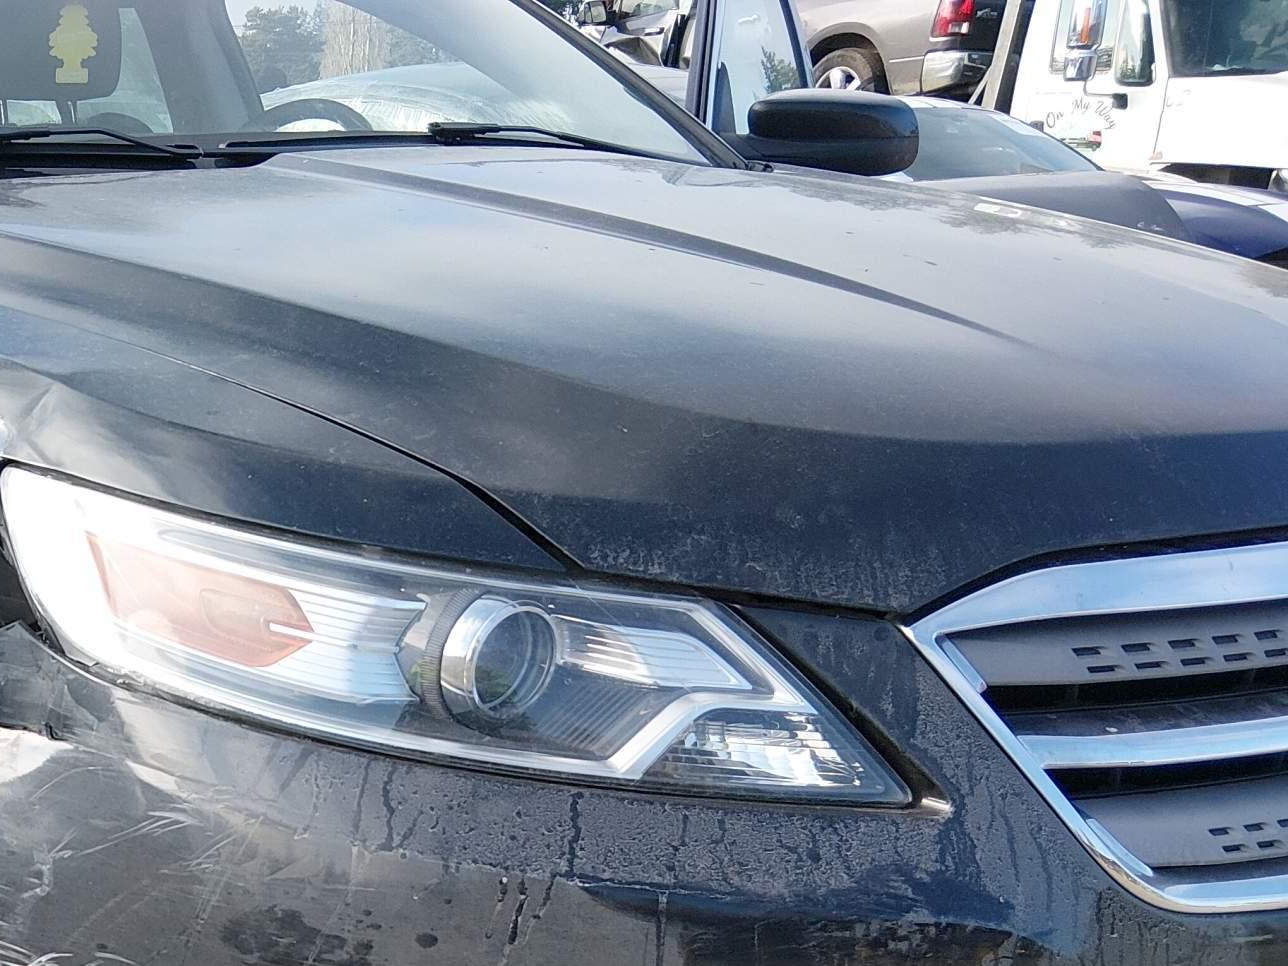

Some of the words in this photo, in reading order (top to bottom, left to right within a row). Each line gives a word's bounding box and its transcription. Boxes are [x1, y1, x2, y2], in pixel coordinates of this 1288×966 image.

[1046, 111, 1064, 128] On
[1072, 96, 1090, 115] My
[1094, 100, 1116, 130] Way
